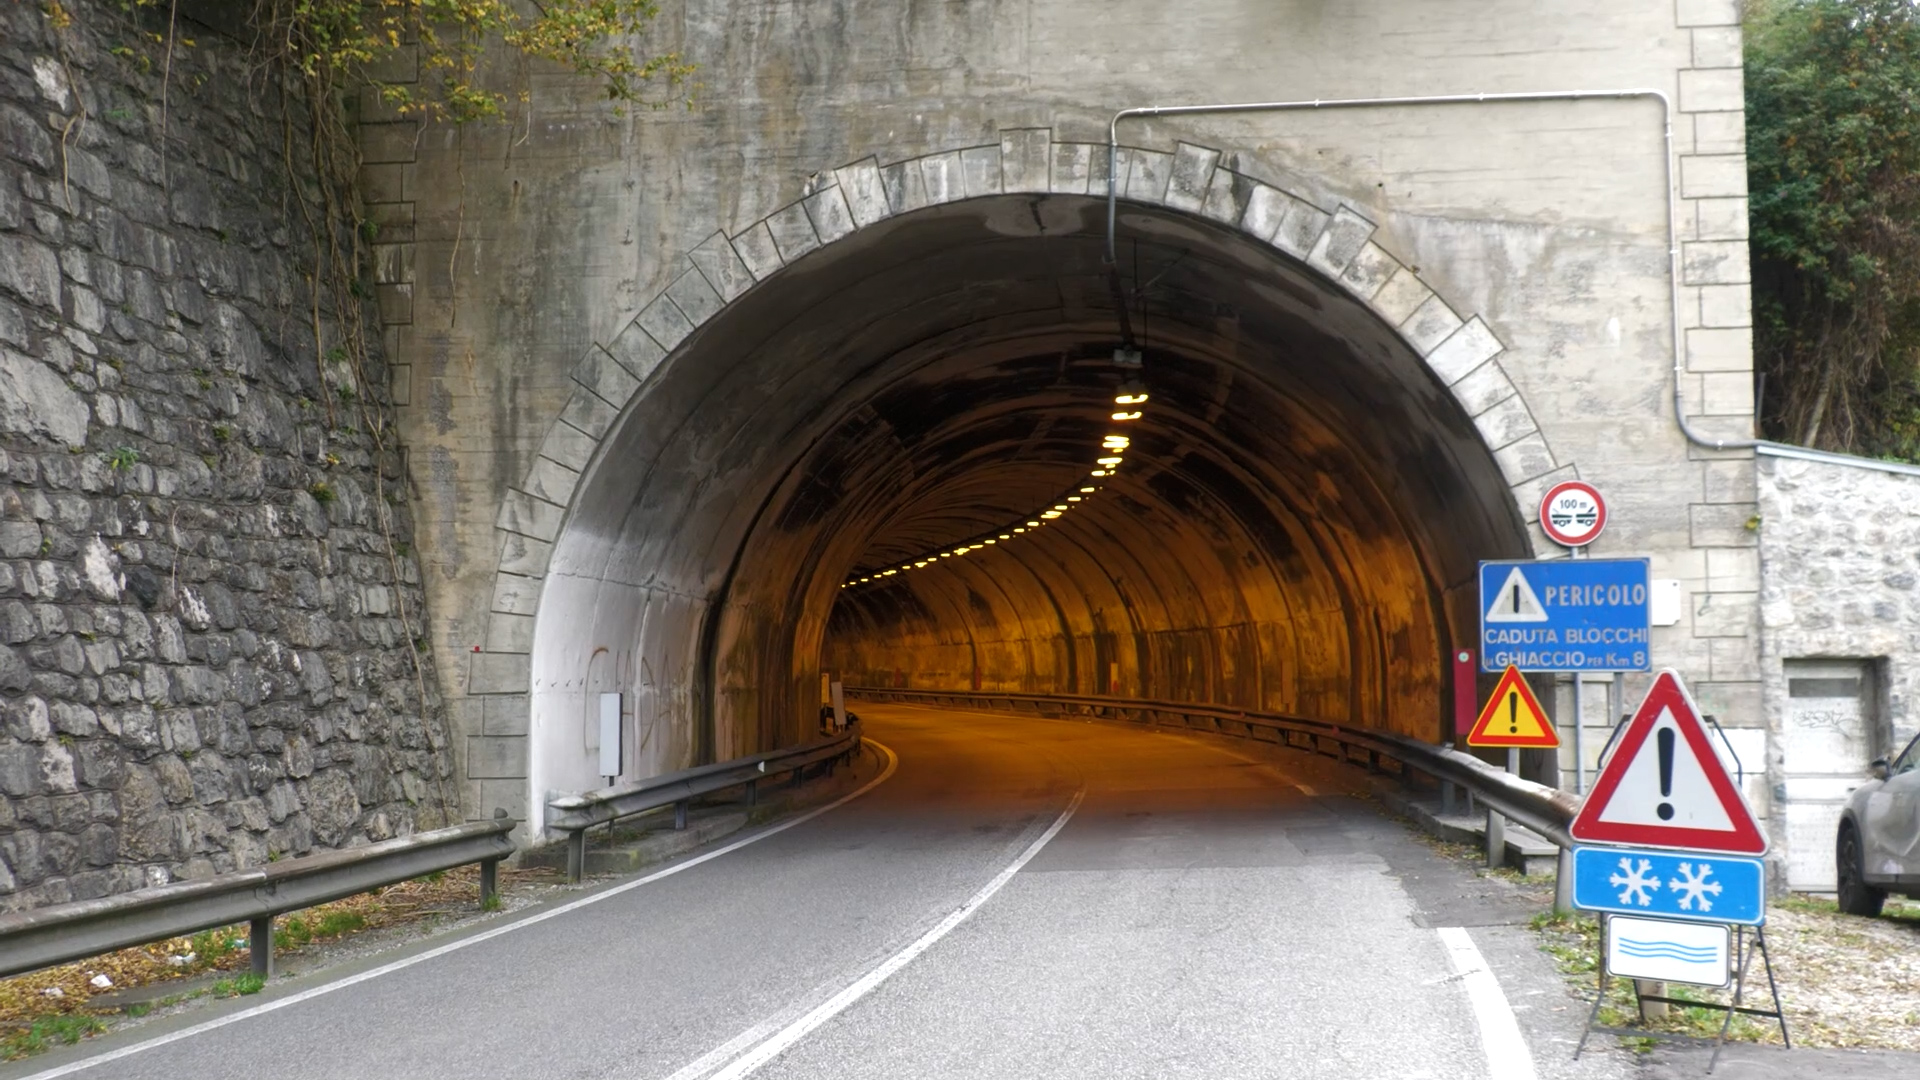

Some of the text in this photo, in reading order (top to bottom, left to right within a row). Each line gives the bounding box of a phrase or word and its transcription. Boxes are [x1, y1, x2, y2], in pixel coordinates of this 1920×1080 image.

[1560, 499, 1578, 509] 100
[1545, 583, 1646, 607] PERICOLO
[1485, 627, 1648, 645] CADUTA BLOCCHI
[1495, 651, 1585, 667] GHIACCIO
[1606, 653, 1630, 667] Km
[1633, 651, 1646, 667] 8
